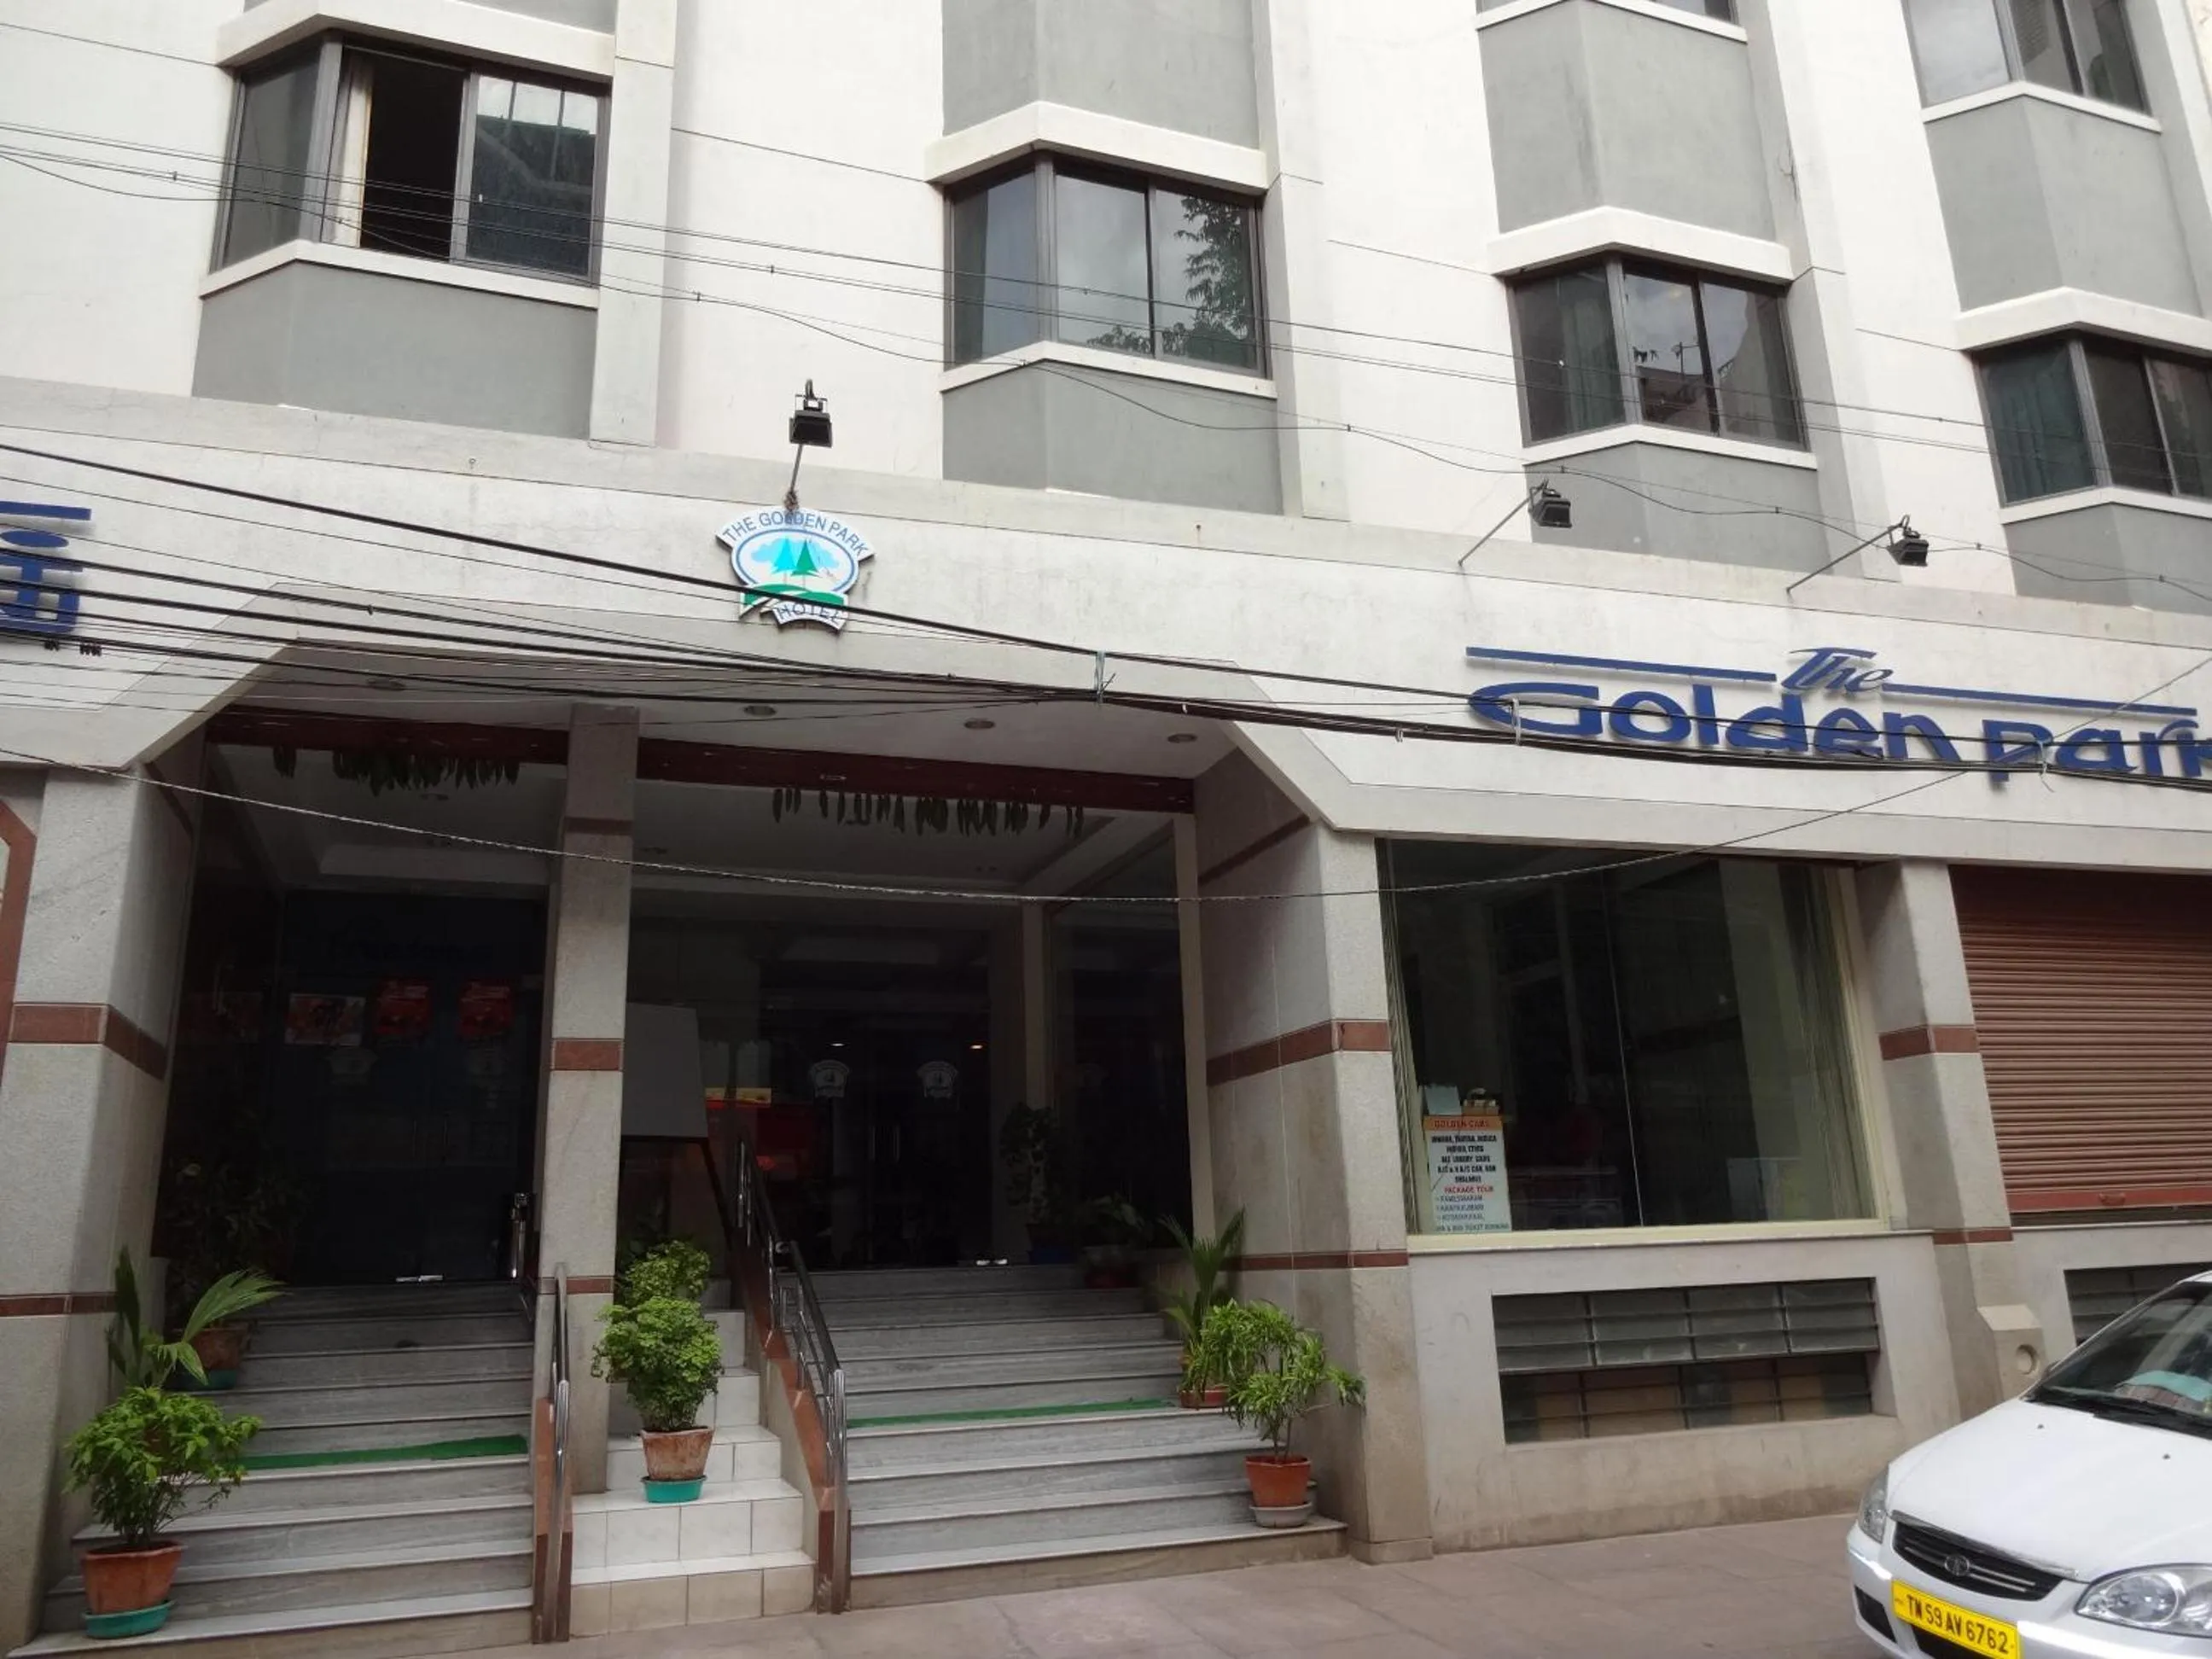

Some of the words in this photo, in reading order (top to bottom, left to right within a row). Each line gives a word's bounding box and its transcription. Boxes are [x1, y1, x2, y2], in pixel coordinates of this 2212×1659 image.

[723, 517, 757, 542] THE
[759, 510, 826, 532] GOLDEN
[829, 523, 869, 556] PARK
[776, 602, 841, 626] HOTEL
[1781, 647, 1893, 693] The
[1468, 681, 1961, 762] Golden
[1946, 1612, 1962, 1637] AV
[1966, 1620, 2009, 1654] 6762
